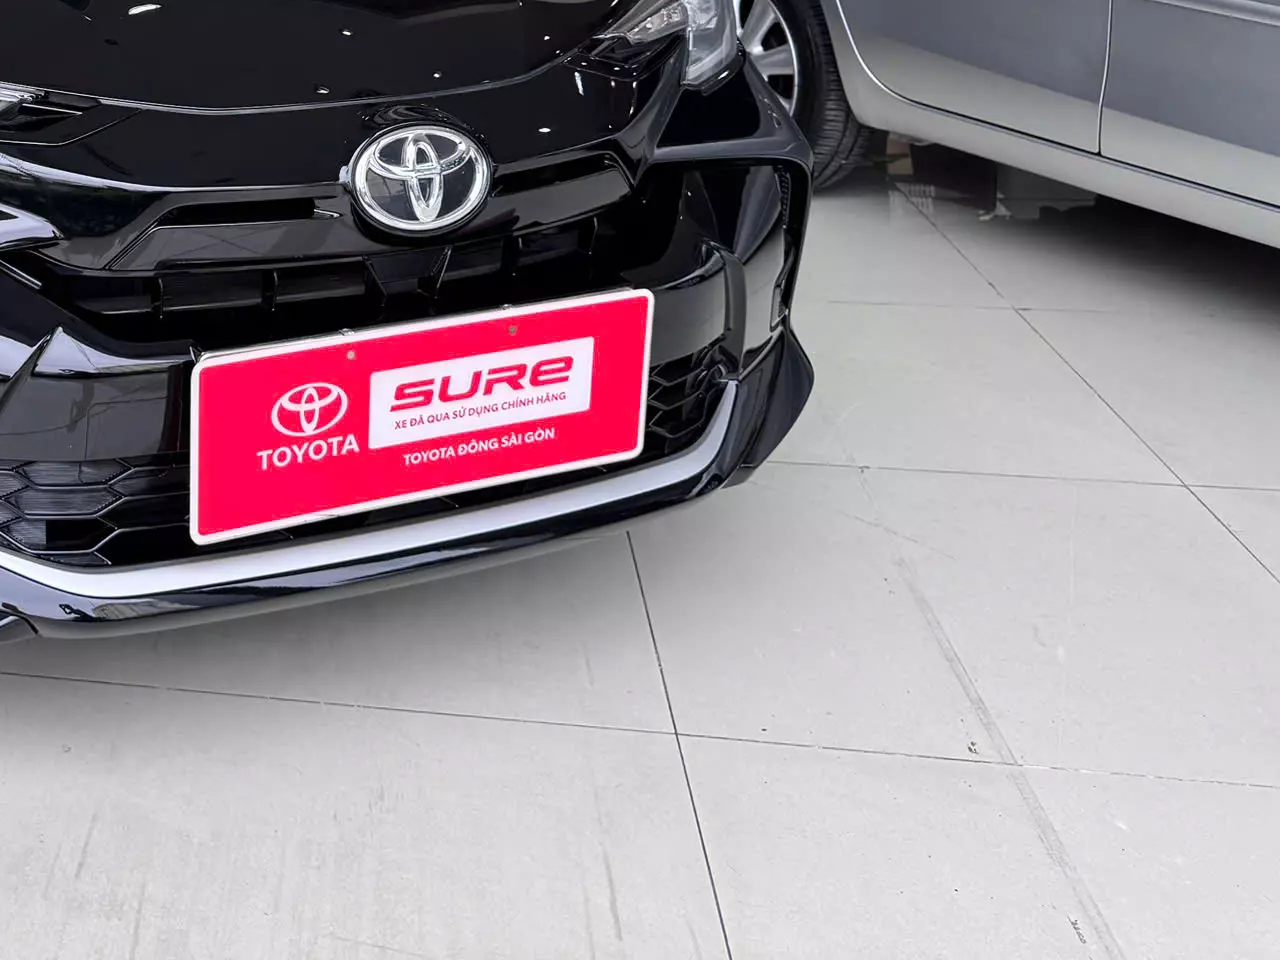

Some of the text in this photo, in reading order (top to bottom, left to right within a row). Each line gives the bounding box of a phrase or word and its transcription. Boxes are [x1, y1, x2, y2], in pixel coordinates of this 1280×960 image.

[394, 390, 567, 430] XE ĐÃ QUA SỬ DỤNG CHÍNH HÃNG
[256, 433, 360, 471] TOYOTA
[404, 426, 556, 466] TOYOTA ĐÔNG SÀI GÒN
